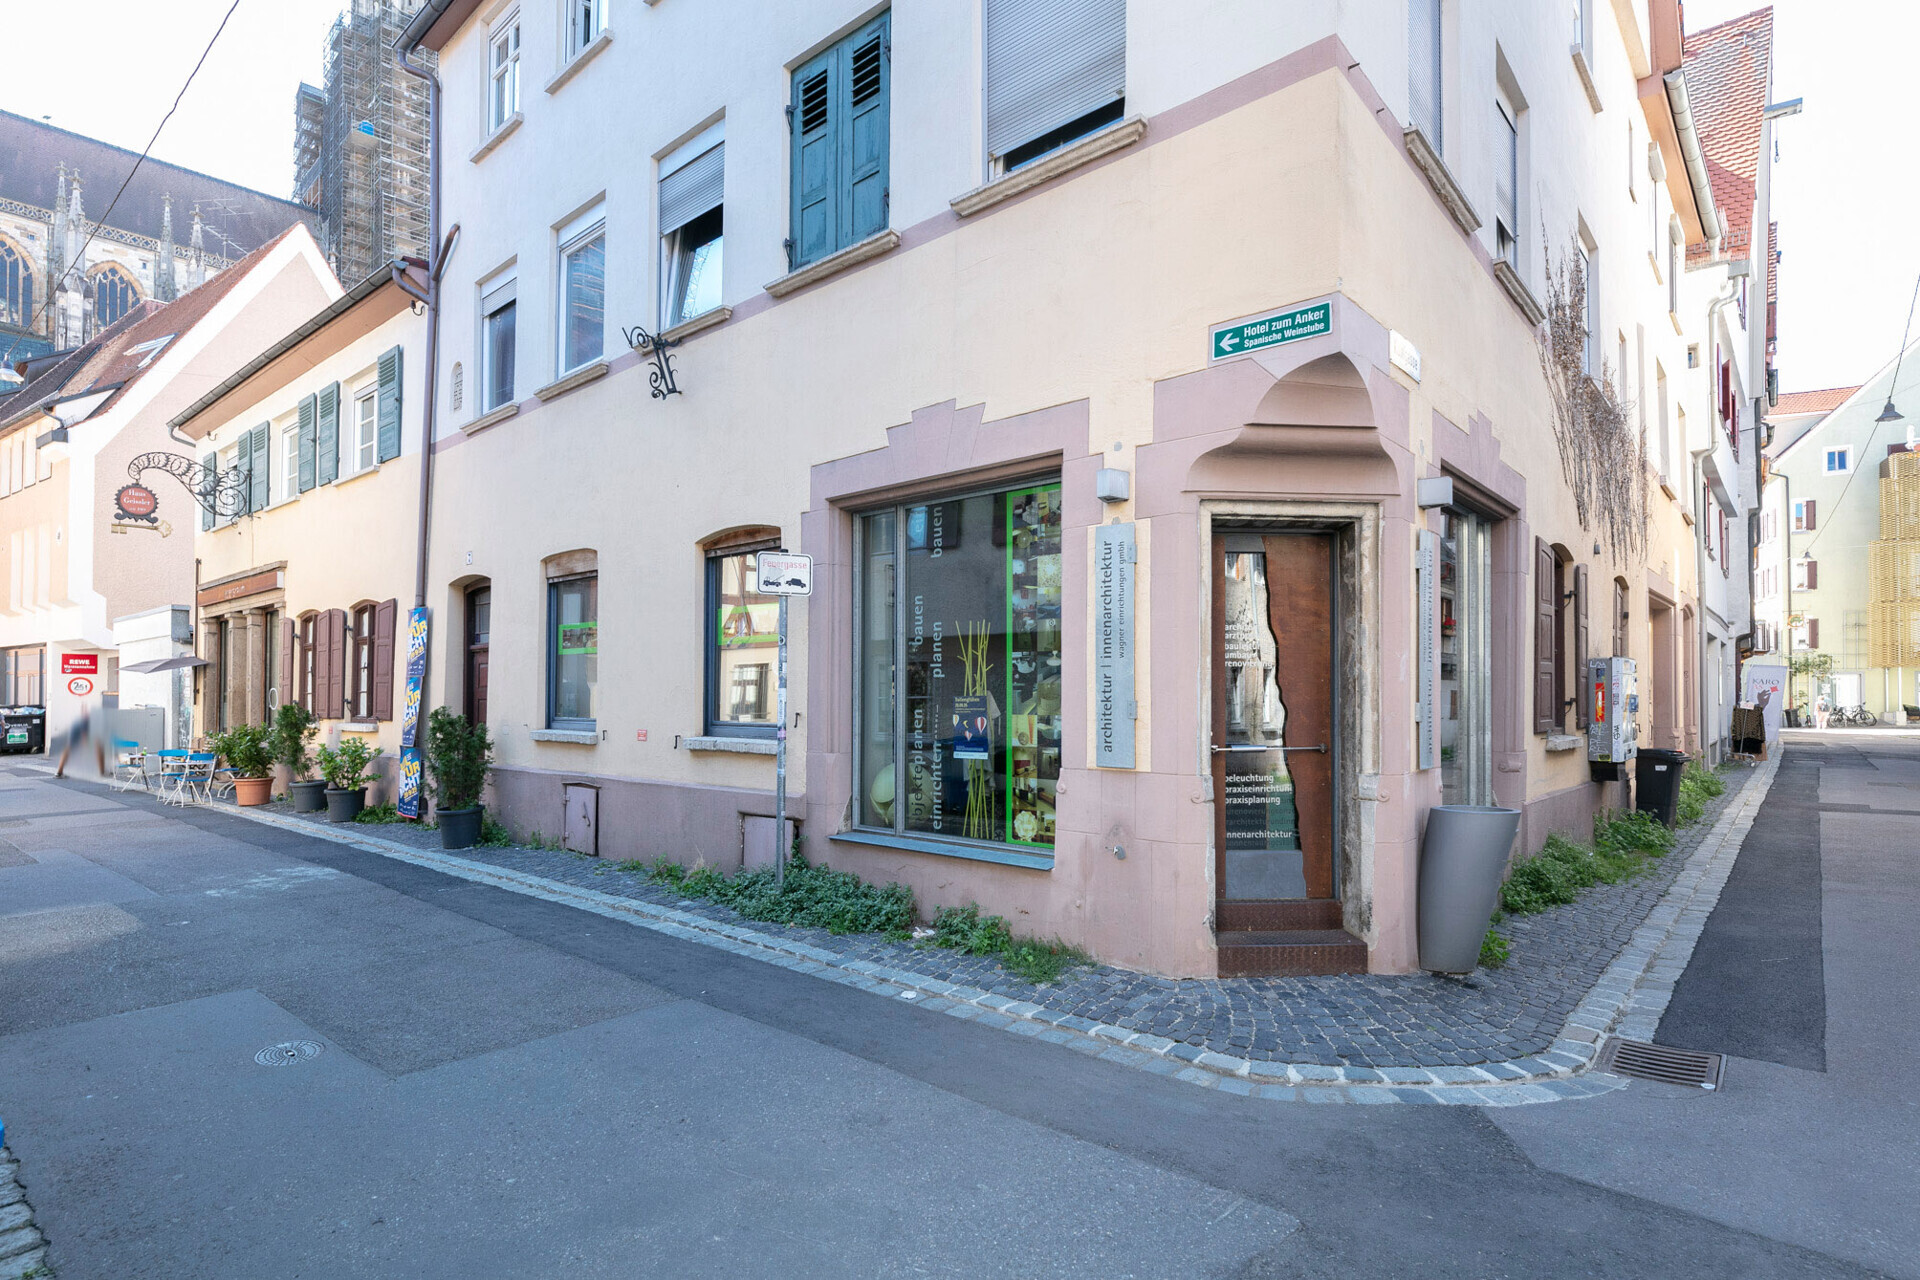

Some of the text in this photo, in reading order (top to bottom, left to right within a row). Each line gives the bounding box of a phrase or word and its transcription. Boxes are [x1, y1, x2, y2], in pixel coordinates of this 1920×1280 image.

[1243, 322, 1324, 348] Spanische Weinstube
[1244, 310, 1324, 337] Hotel zum Anker
[762, 558, 807, 571] Feuergasse
[1118, 541, 1127, 659] wagner einrichtungen gmbh
[908, 595, 923, 646] bauen
[1101, 541, 1113, 753] architektur innenarchitektur
[930, 506, 945, 830] einrichten planen bauen
[1225, 774, 1274, 783] beleuchtung
[1225, 795, 1281, 805] praxisplanung
[1226, 830, 1293, 839] nnenarchitektur
